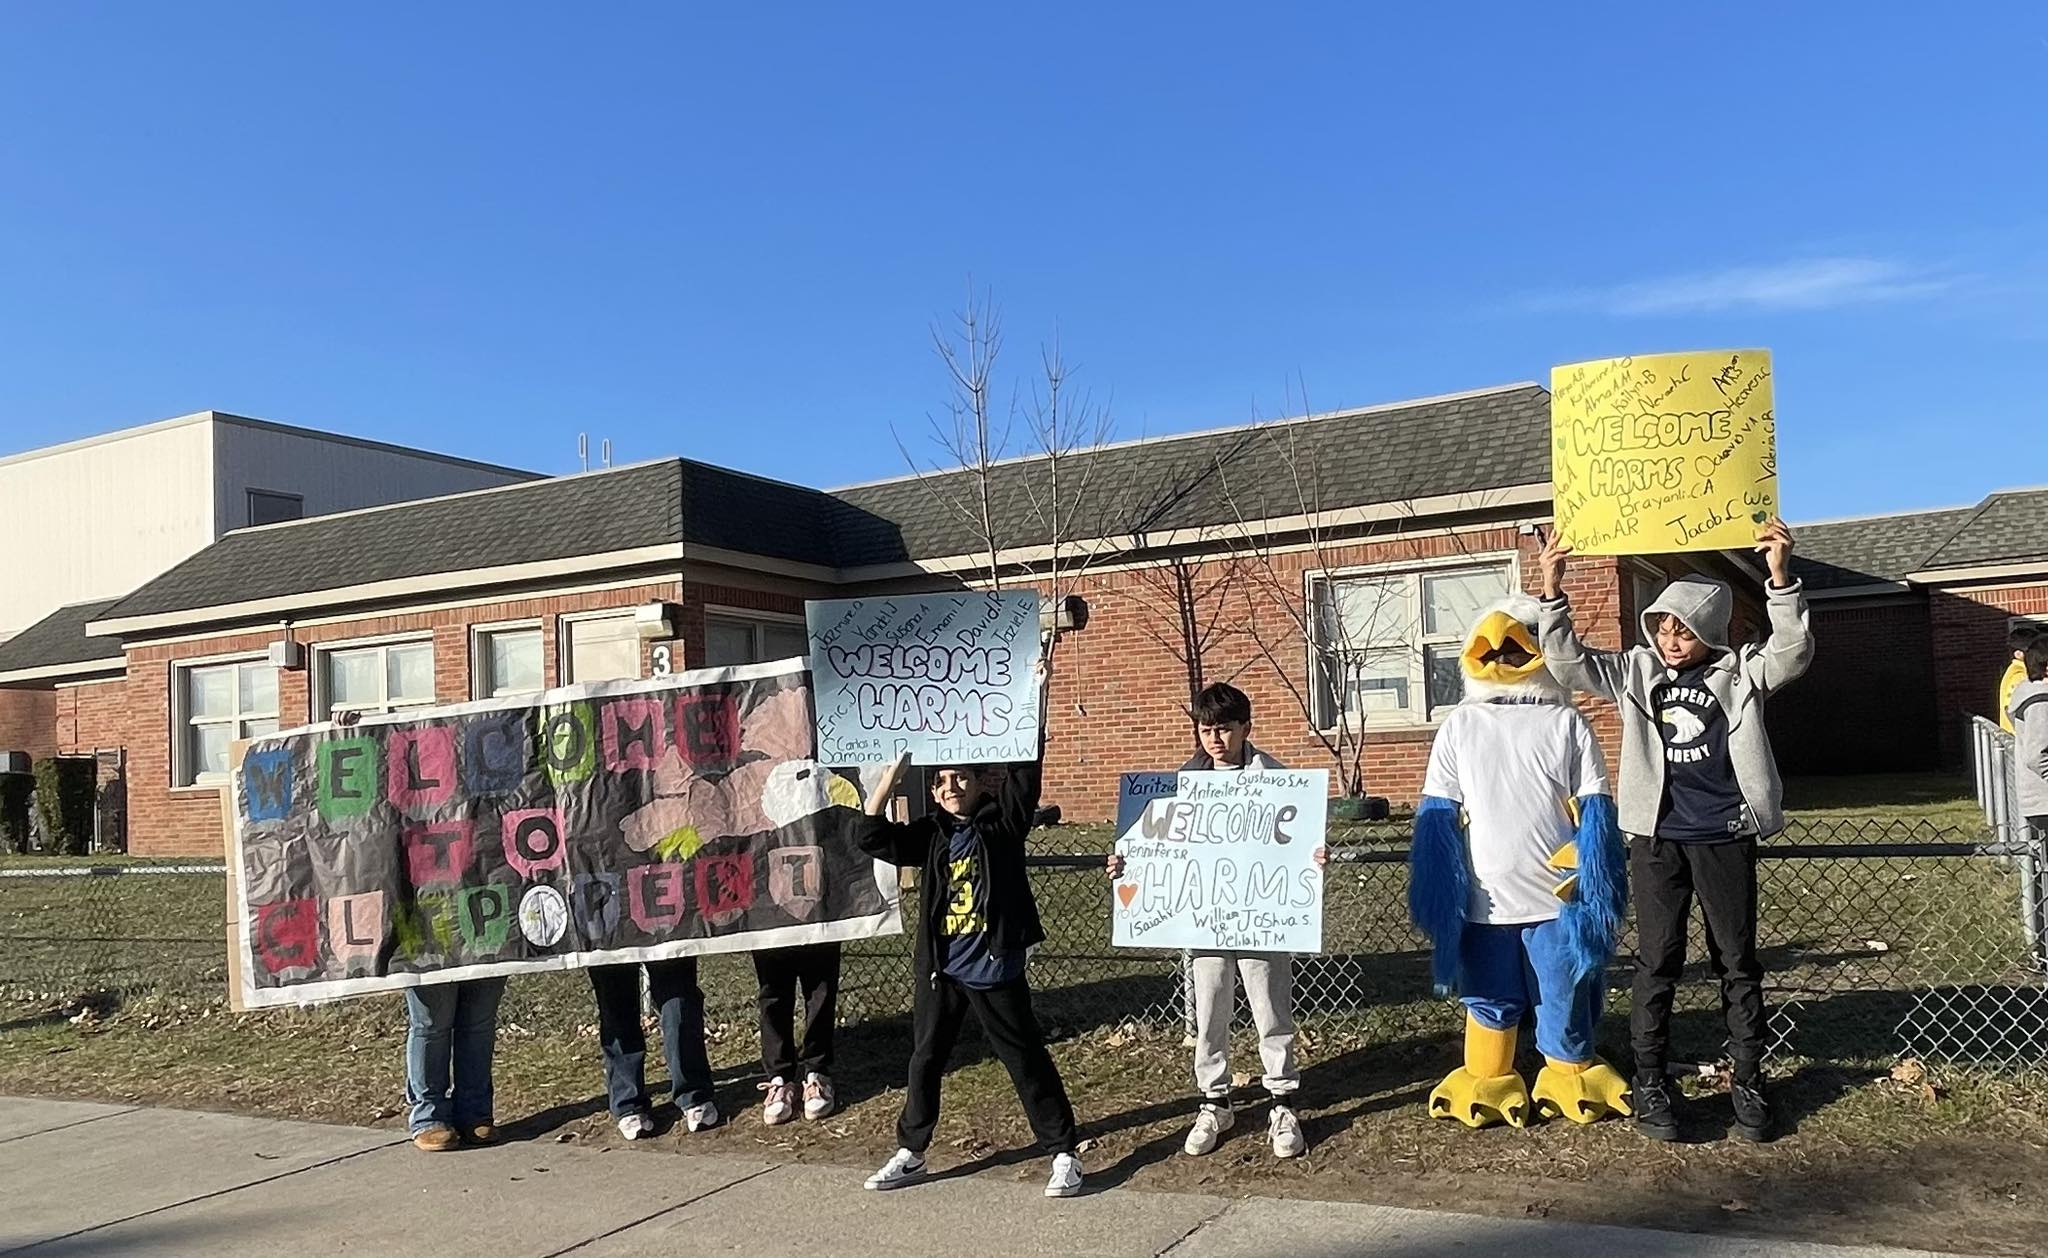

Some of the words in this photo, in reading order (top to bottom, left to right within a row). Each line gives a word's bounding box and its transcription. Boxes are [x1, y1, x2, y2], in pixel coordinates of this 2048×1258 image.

[1572, 410, 1732, 456] WELCOME
[1589, 456, 1685, 498] HARMS
[653, 645, 671, 677] 3
[827, 643, 1013, 687] WELCOME
[857, 682, 1014, 738] HARMS
[248, 698, 738, 808] WELCOME
[419, 814, 560, 869] TO
[949, 880, 974, 915] 3
[1142, 857, 1318, 913] HARMS
